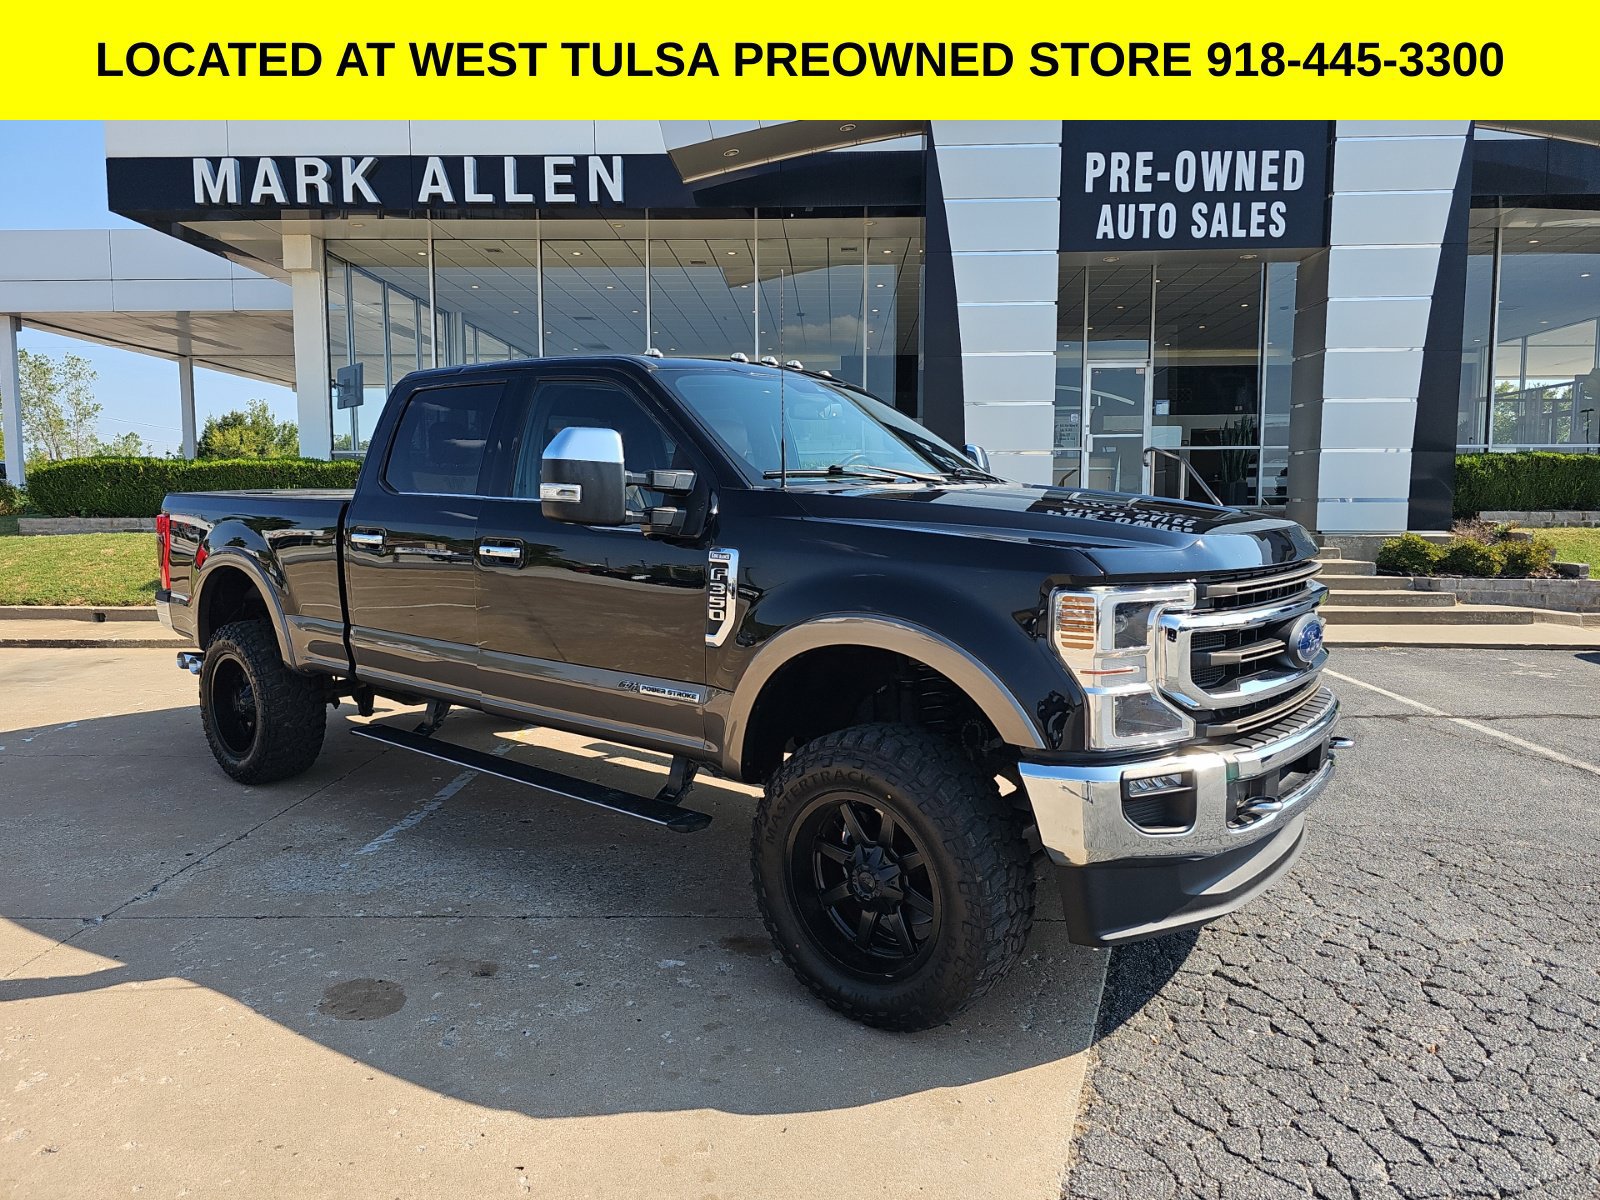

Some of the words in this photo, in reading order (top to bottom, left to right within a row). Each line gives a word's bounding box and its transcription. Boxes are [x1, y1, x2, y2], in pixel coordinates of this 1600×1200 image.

[193, 156, 382, 204] MARK
[418, 155, 625, 204] ALLEN
[1084, 150, 1305, 193] PRE-OWNED
[1095, 202, 1177, 240] AUTO
[1190, 201, 1287, 239] SALES
[641, 685, 666, 695] POWER
[667, 689, 698, 700] STROKE
[765, 768, 873, 845] MASTERTRACK
